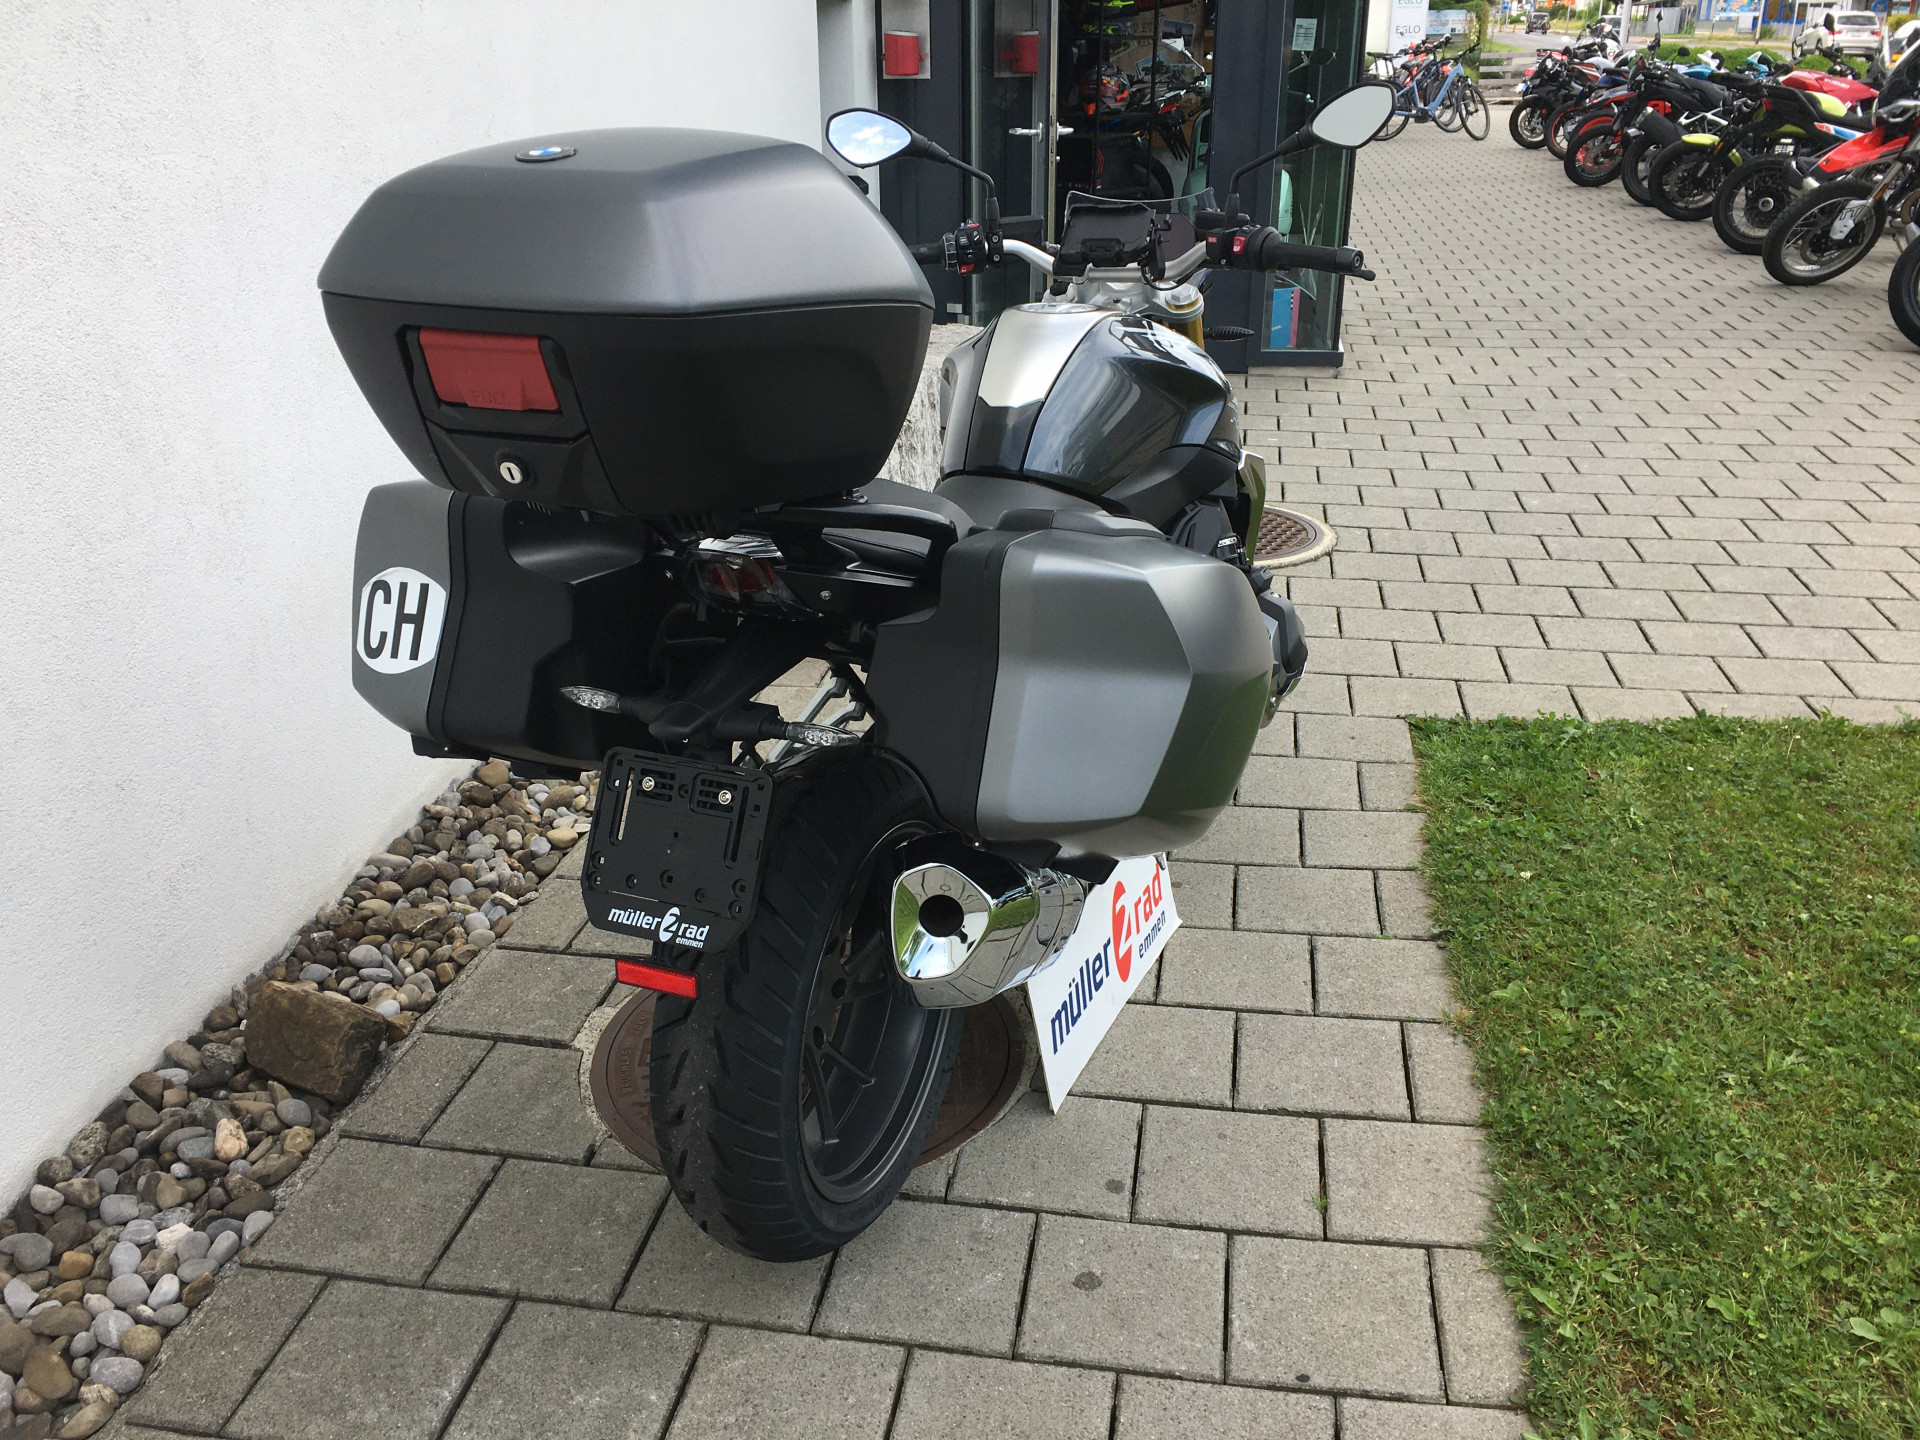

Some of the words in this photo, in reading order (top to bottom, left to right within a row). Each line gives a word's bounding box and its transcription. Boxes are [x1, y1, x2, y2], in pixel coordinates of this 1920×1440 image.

[363, 579, 430, 661] CH
[675, 936, 704, 949] emmen
[1138, 910, 1166, 959] emmen
